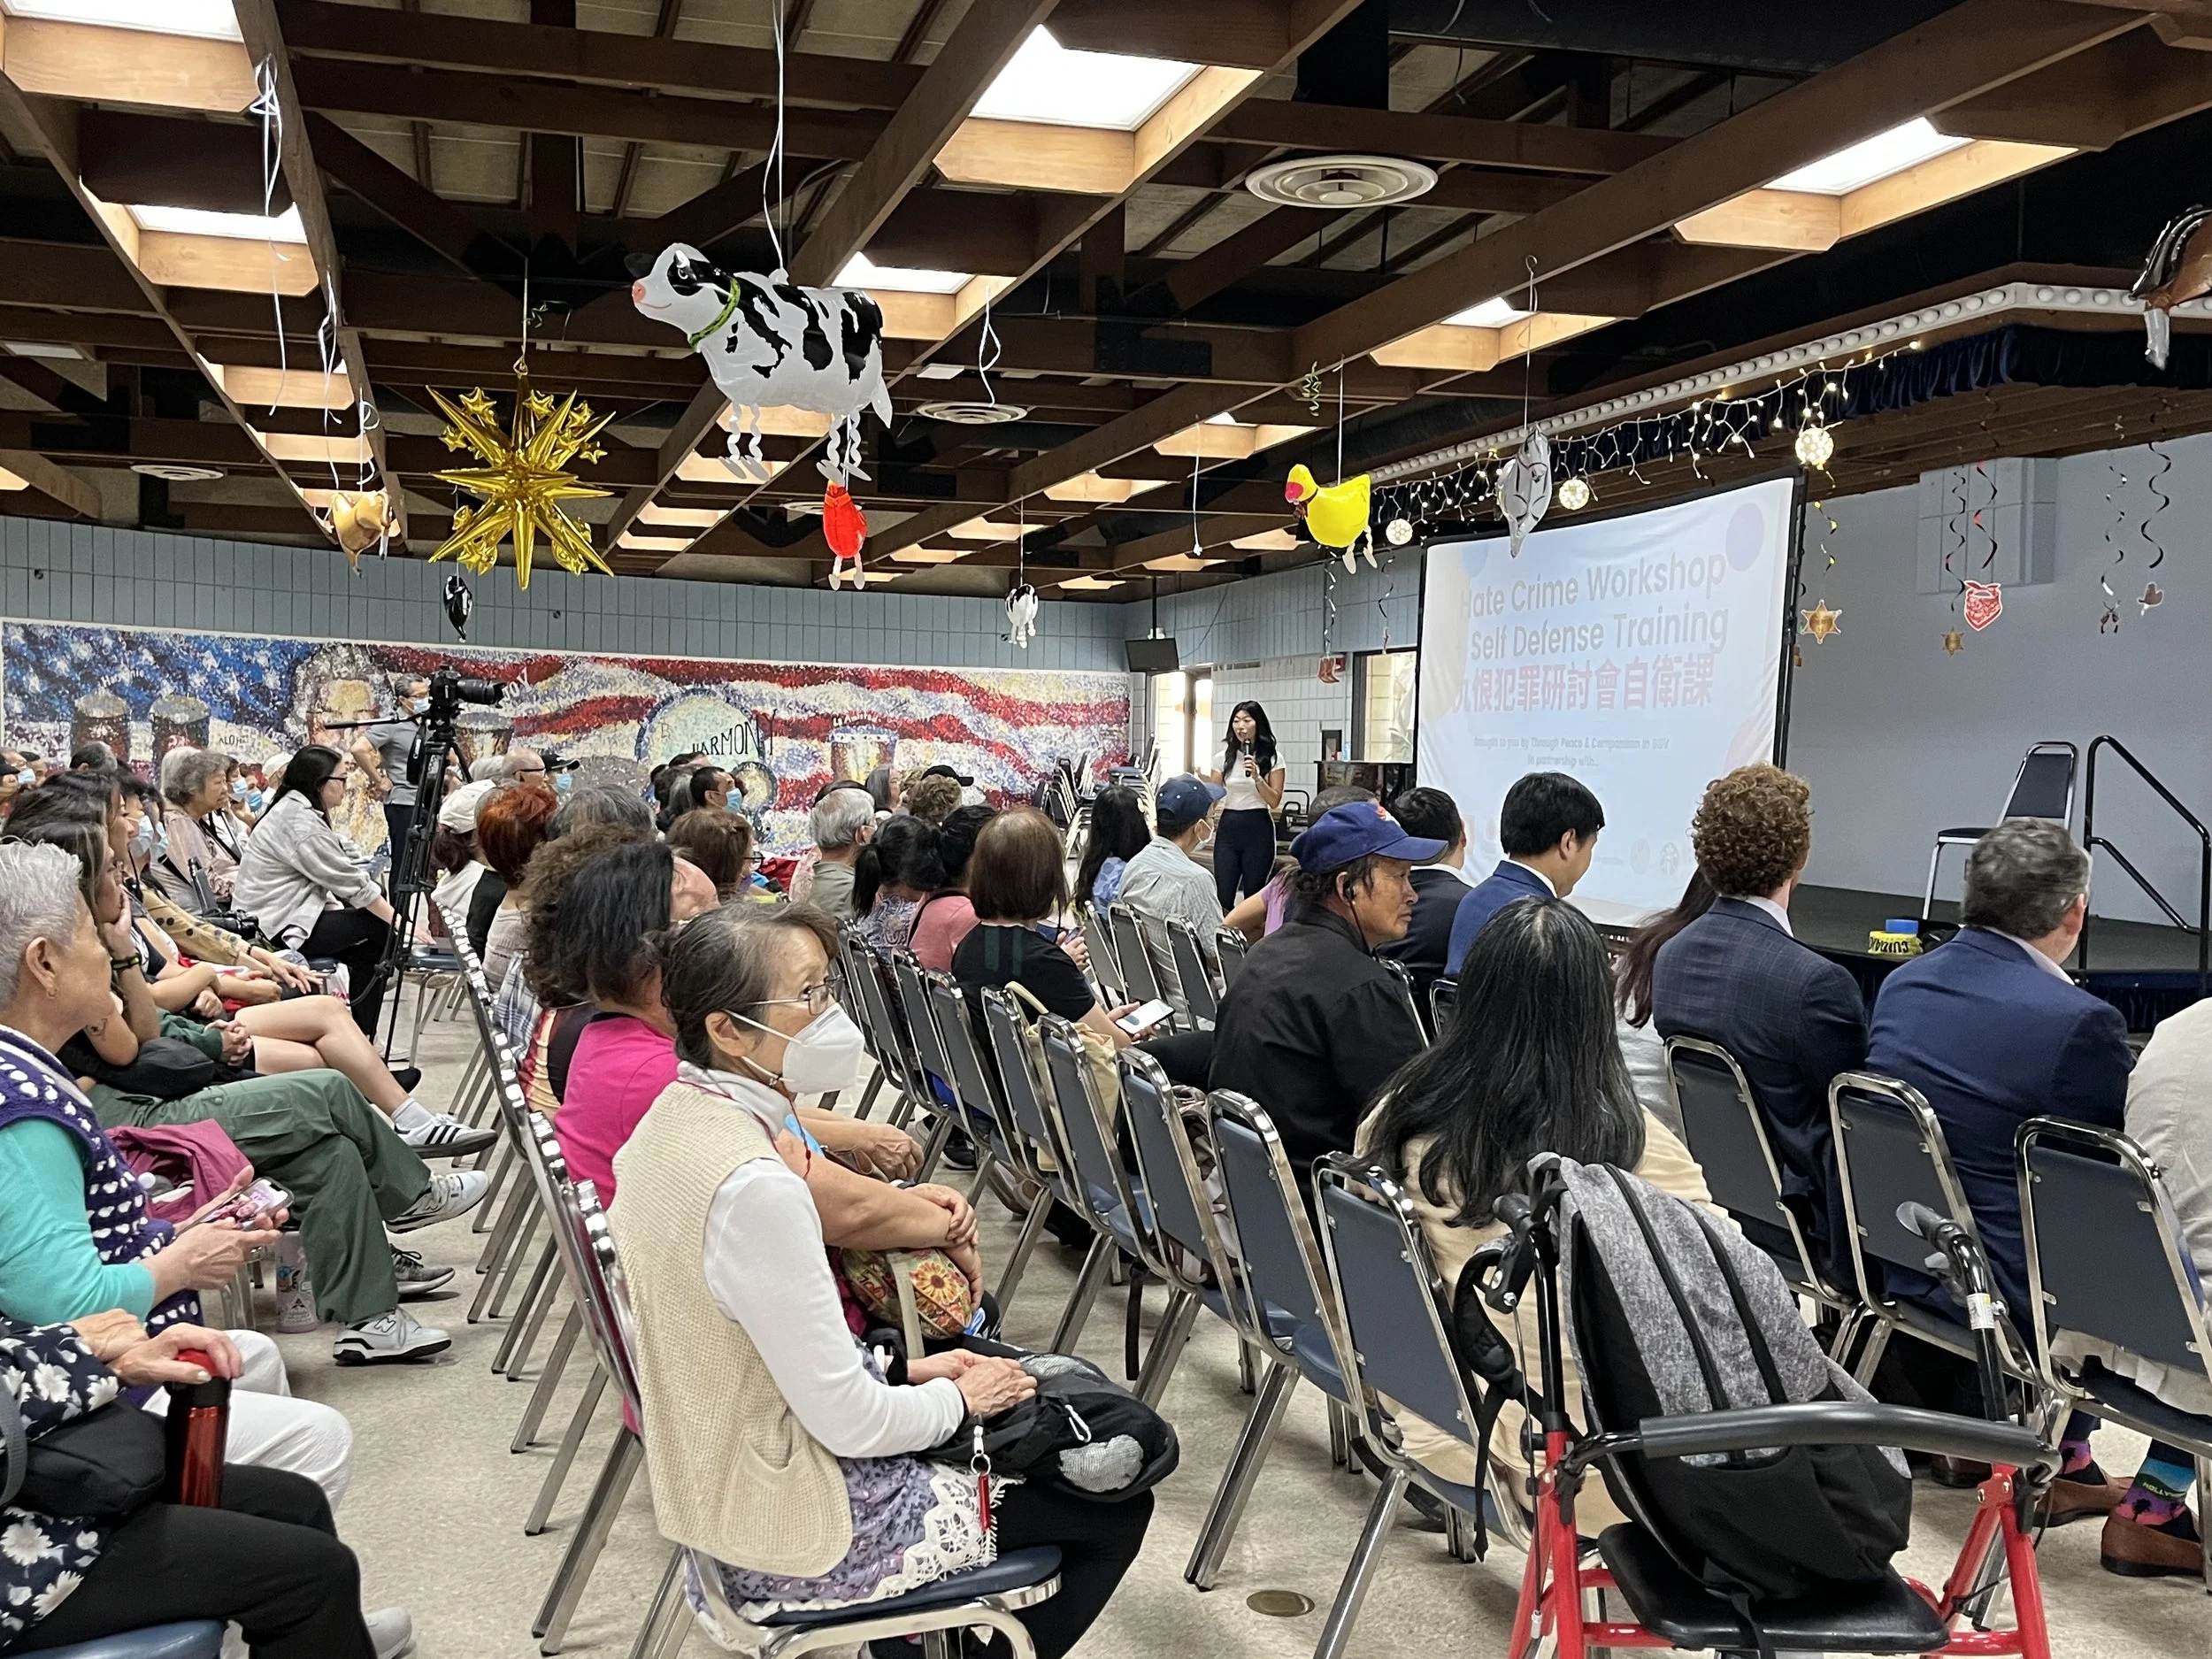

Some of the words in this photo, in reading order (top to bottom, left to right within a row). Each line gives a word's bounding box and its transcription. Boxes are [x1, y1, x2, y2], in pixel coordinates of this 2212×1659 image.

[1461, 586, 1505, 618] Hate
[1511, 573, 1579, 611] Crime
[1586, 552, 1726, 602] Workshop
[1471, 624, 1508, 660] Self
[1513, 619, 1605, 657] Defense
[1614, 602, 1730, 655] Training
[692, 708, 779, 757] HARMONY
[1561, 737, 1583, 749] Peace
[1584, 737, 1591, 749] &
[1592, 737, 1640, 752] Compassion
[1535, 755, 1577, 768] partnership
